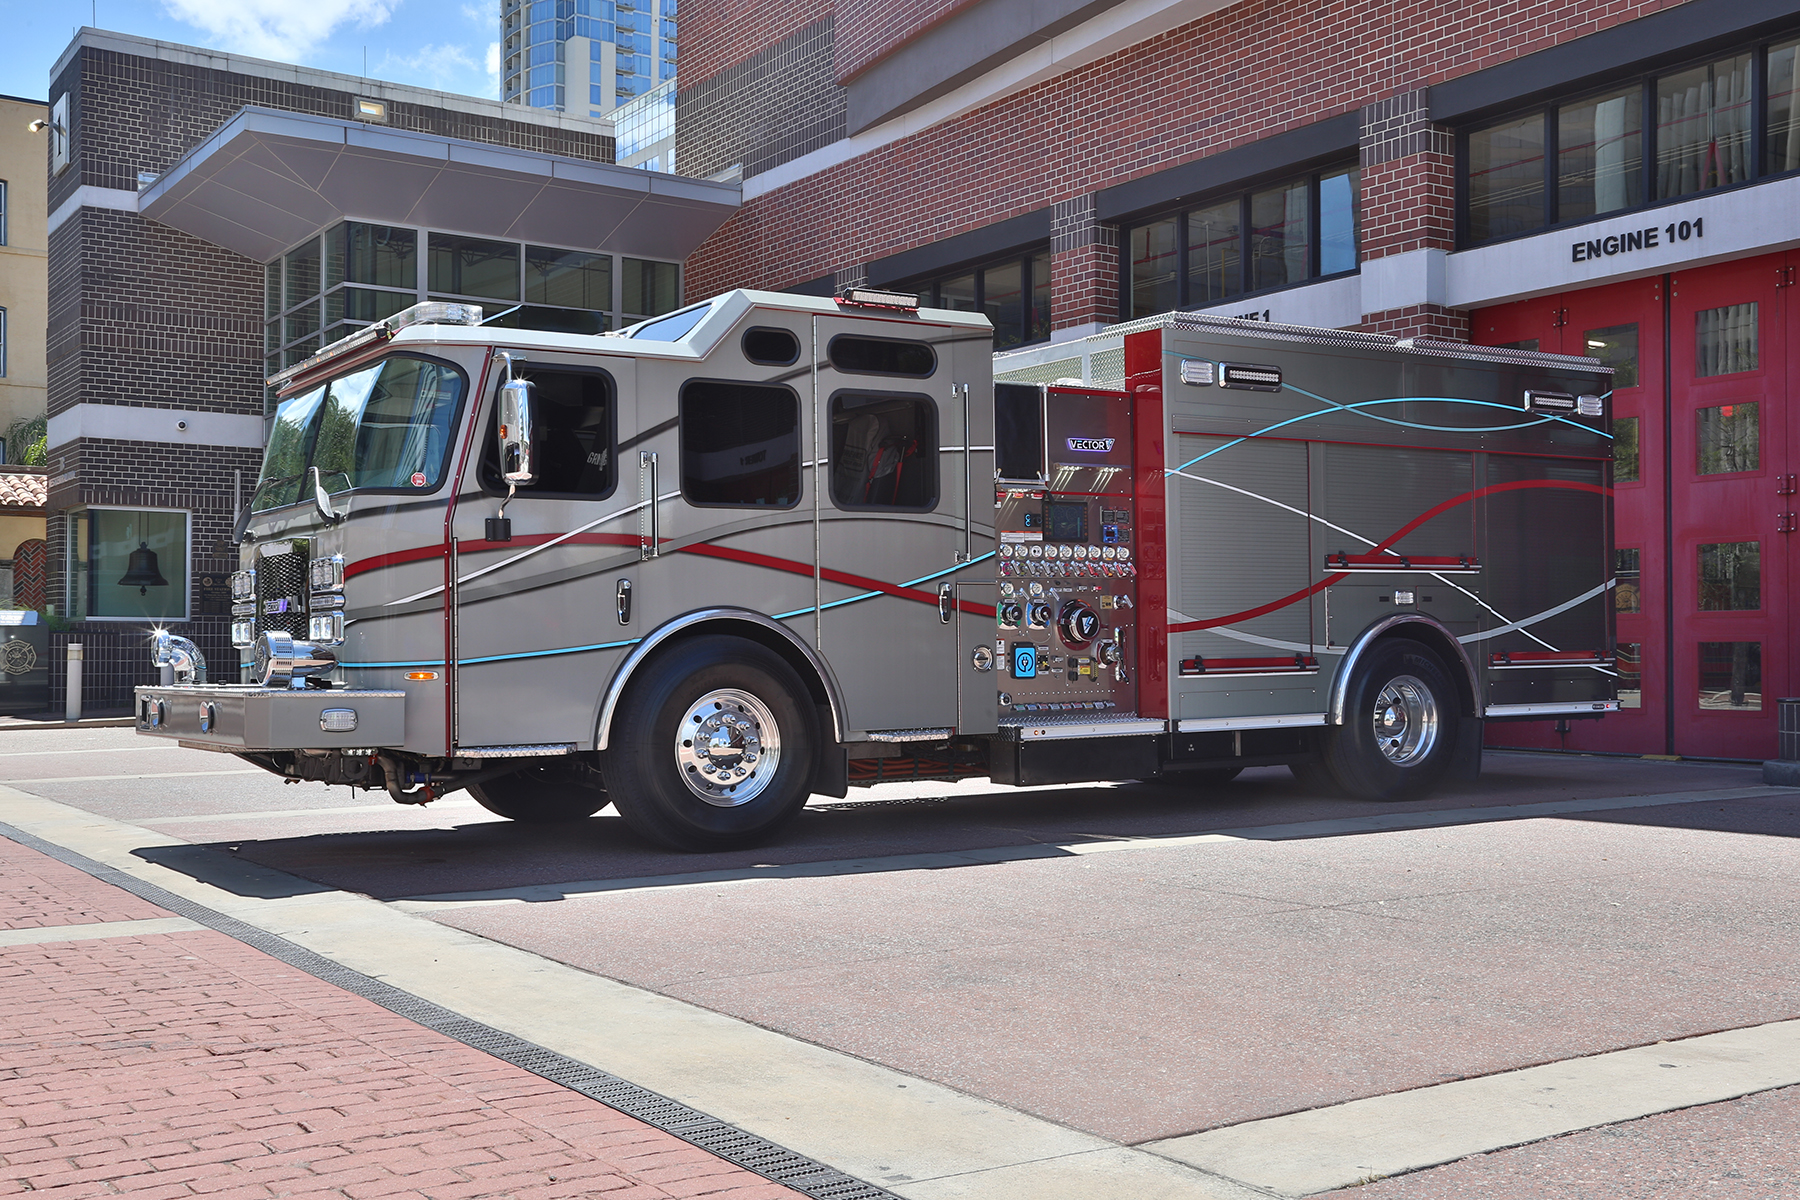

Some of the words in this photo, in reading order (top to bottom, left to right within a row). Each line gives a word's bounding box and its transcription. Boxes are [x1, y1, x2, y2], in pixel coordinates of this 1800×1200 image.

[1572, 227, 1659, 263] ENGINE
[1665, 217, 1703, 243] 101
[1070, 439, 1105, 450] VECTOR
